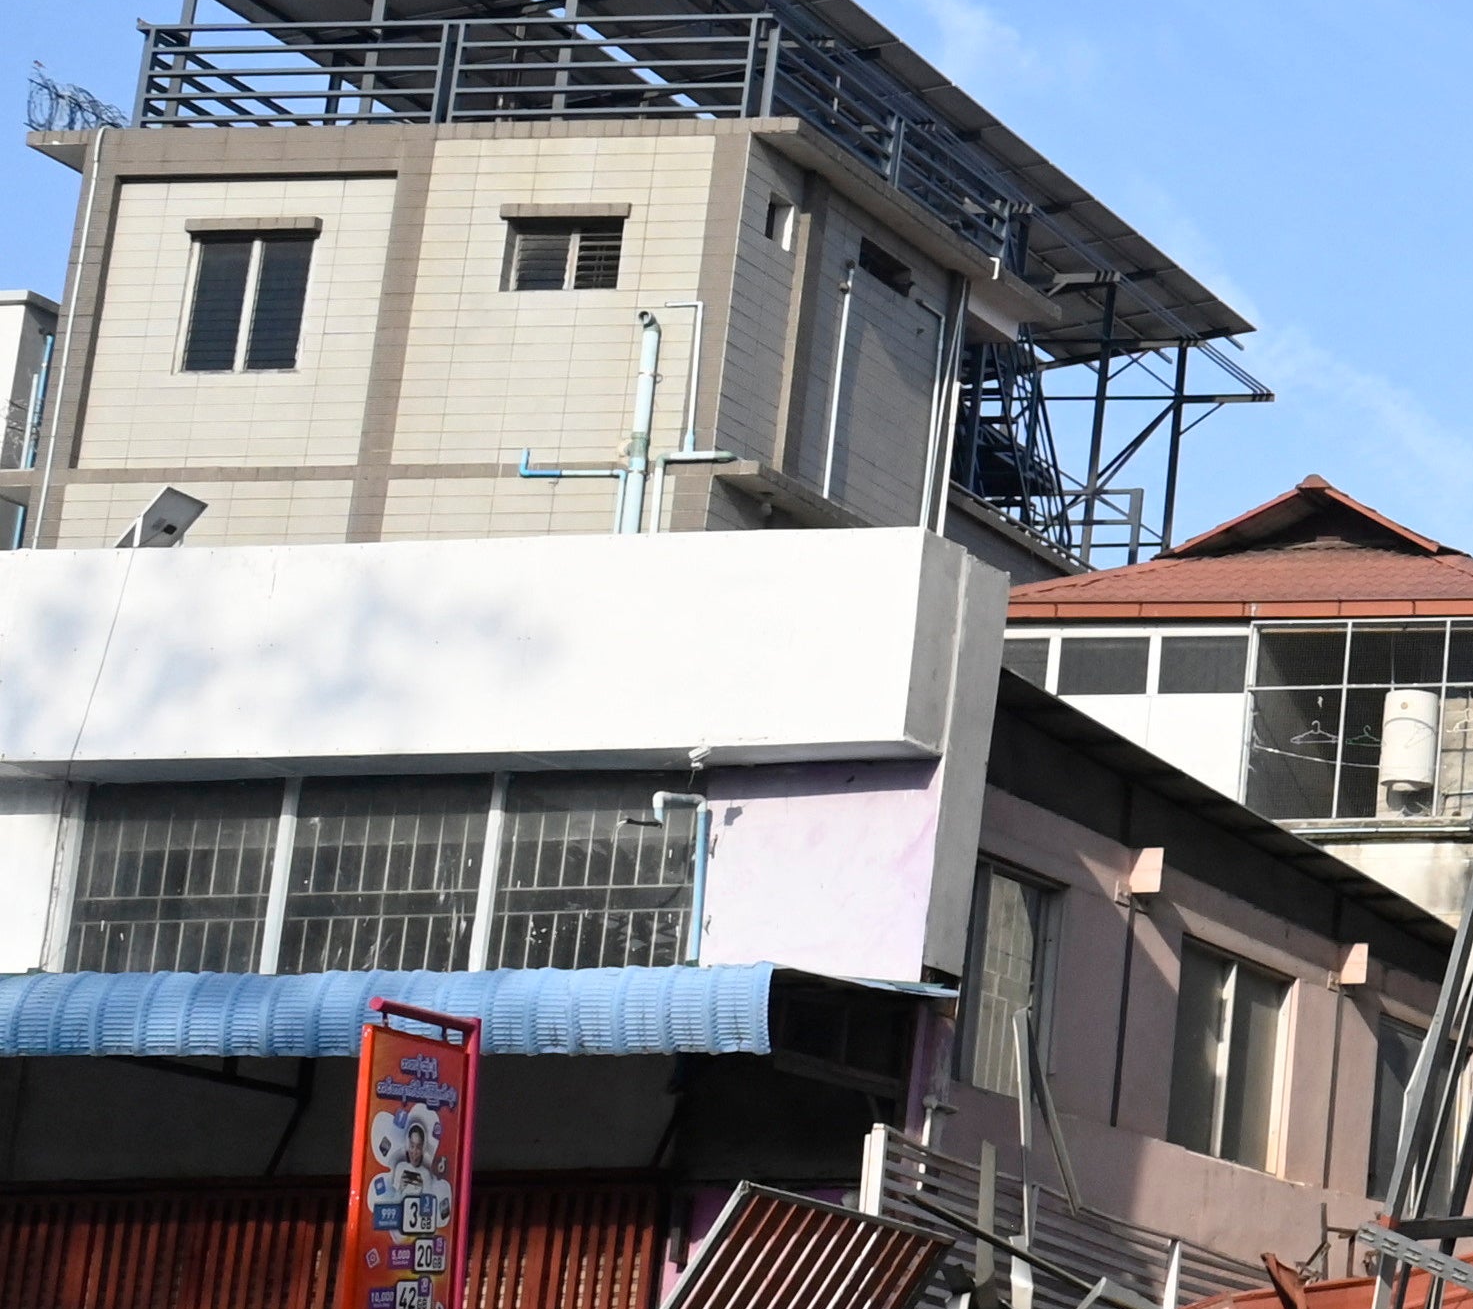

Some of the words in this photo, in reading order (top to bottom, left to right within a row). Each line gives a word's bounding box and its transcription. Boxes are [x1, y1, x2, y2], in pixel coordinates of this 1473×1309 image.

[409, 1201, 418, 1228] 3
[416, 1245, 433, 1268] 20
[399, 1286, 416, 1309] 42
